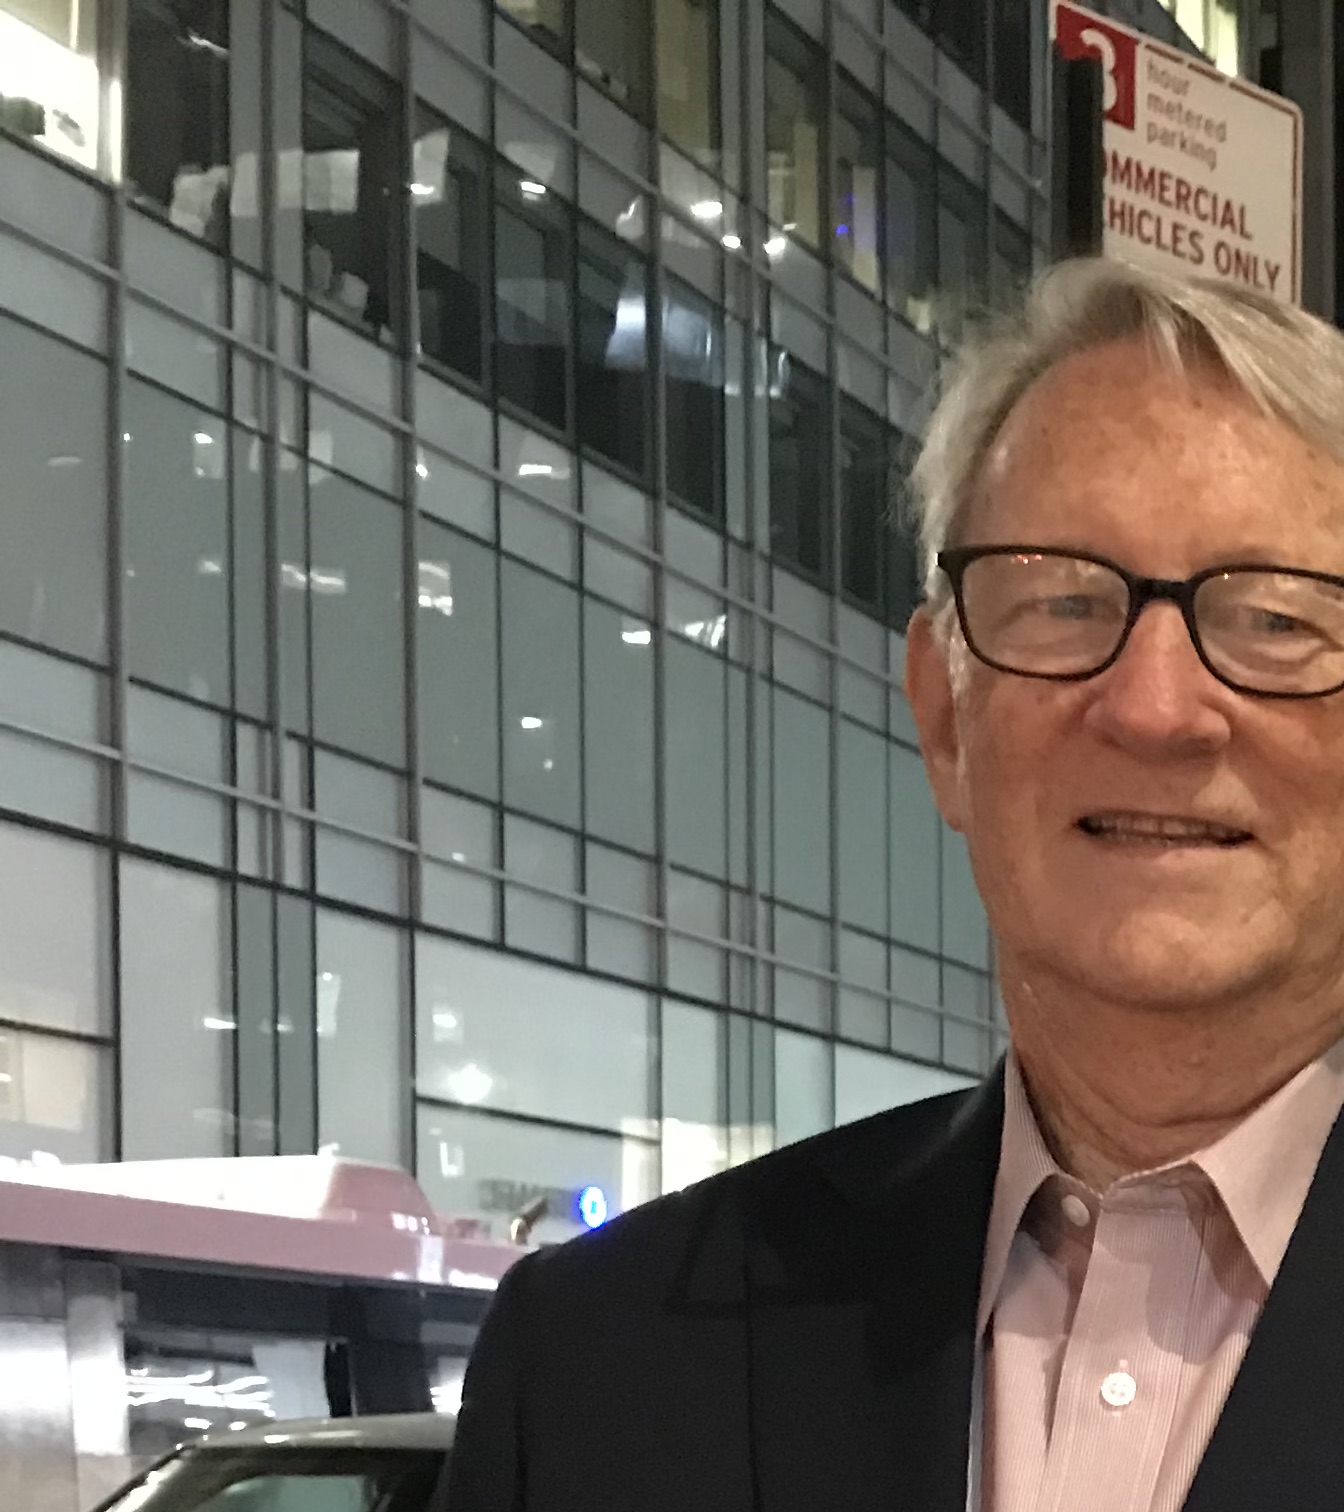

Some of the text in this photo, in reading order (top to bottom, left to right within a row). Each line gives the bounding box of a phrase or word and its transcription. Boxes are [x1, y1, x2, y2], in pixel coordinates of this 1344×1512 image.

[1146, 59, 1190, 96] hour
[1146, 92, 1227, 143] metered
[1146, 121, 1217, 172] parking
[1109, 149, 1253, 241] MMERCIAL
[1108, 196, 1281, 292] HICLES ONLY
